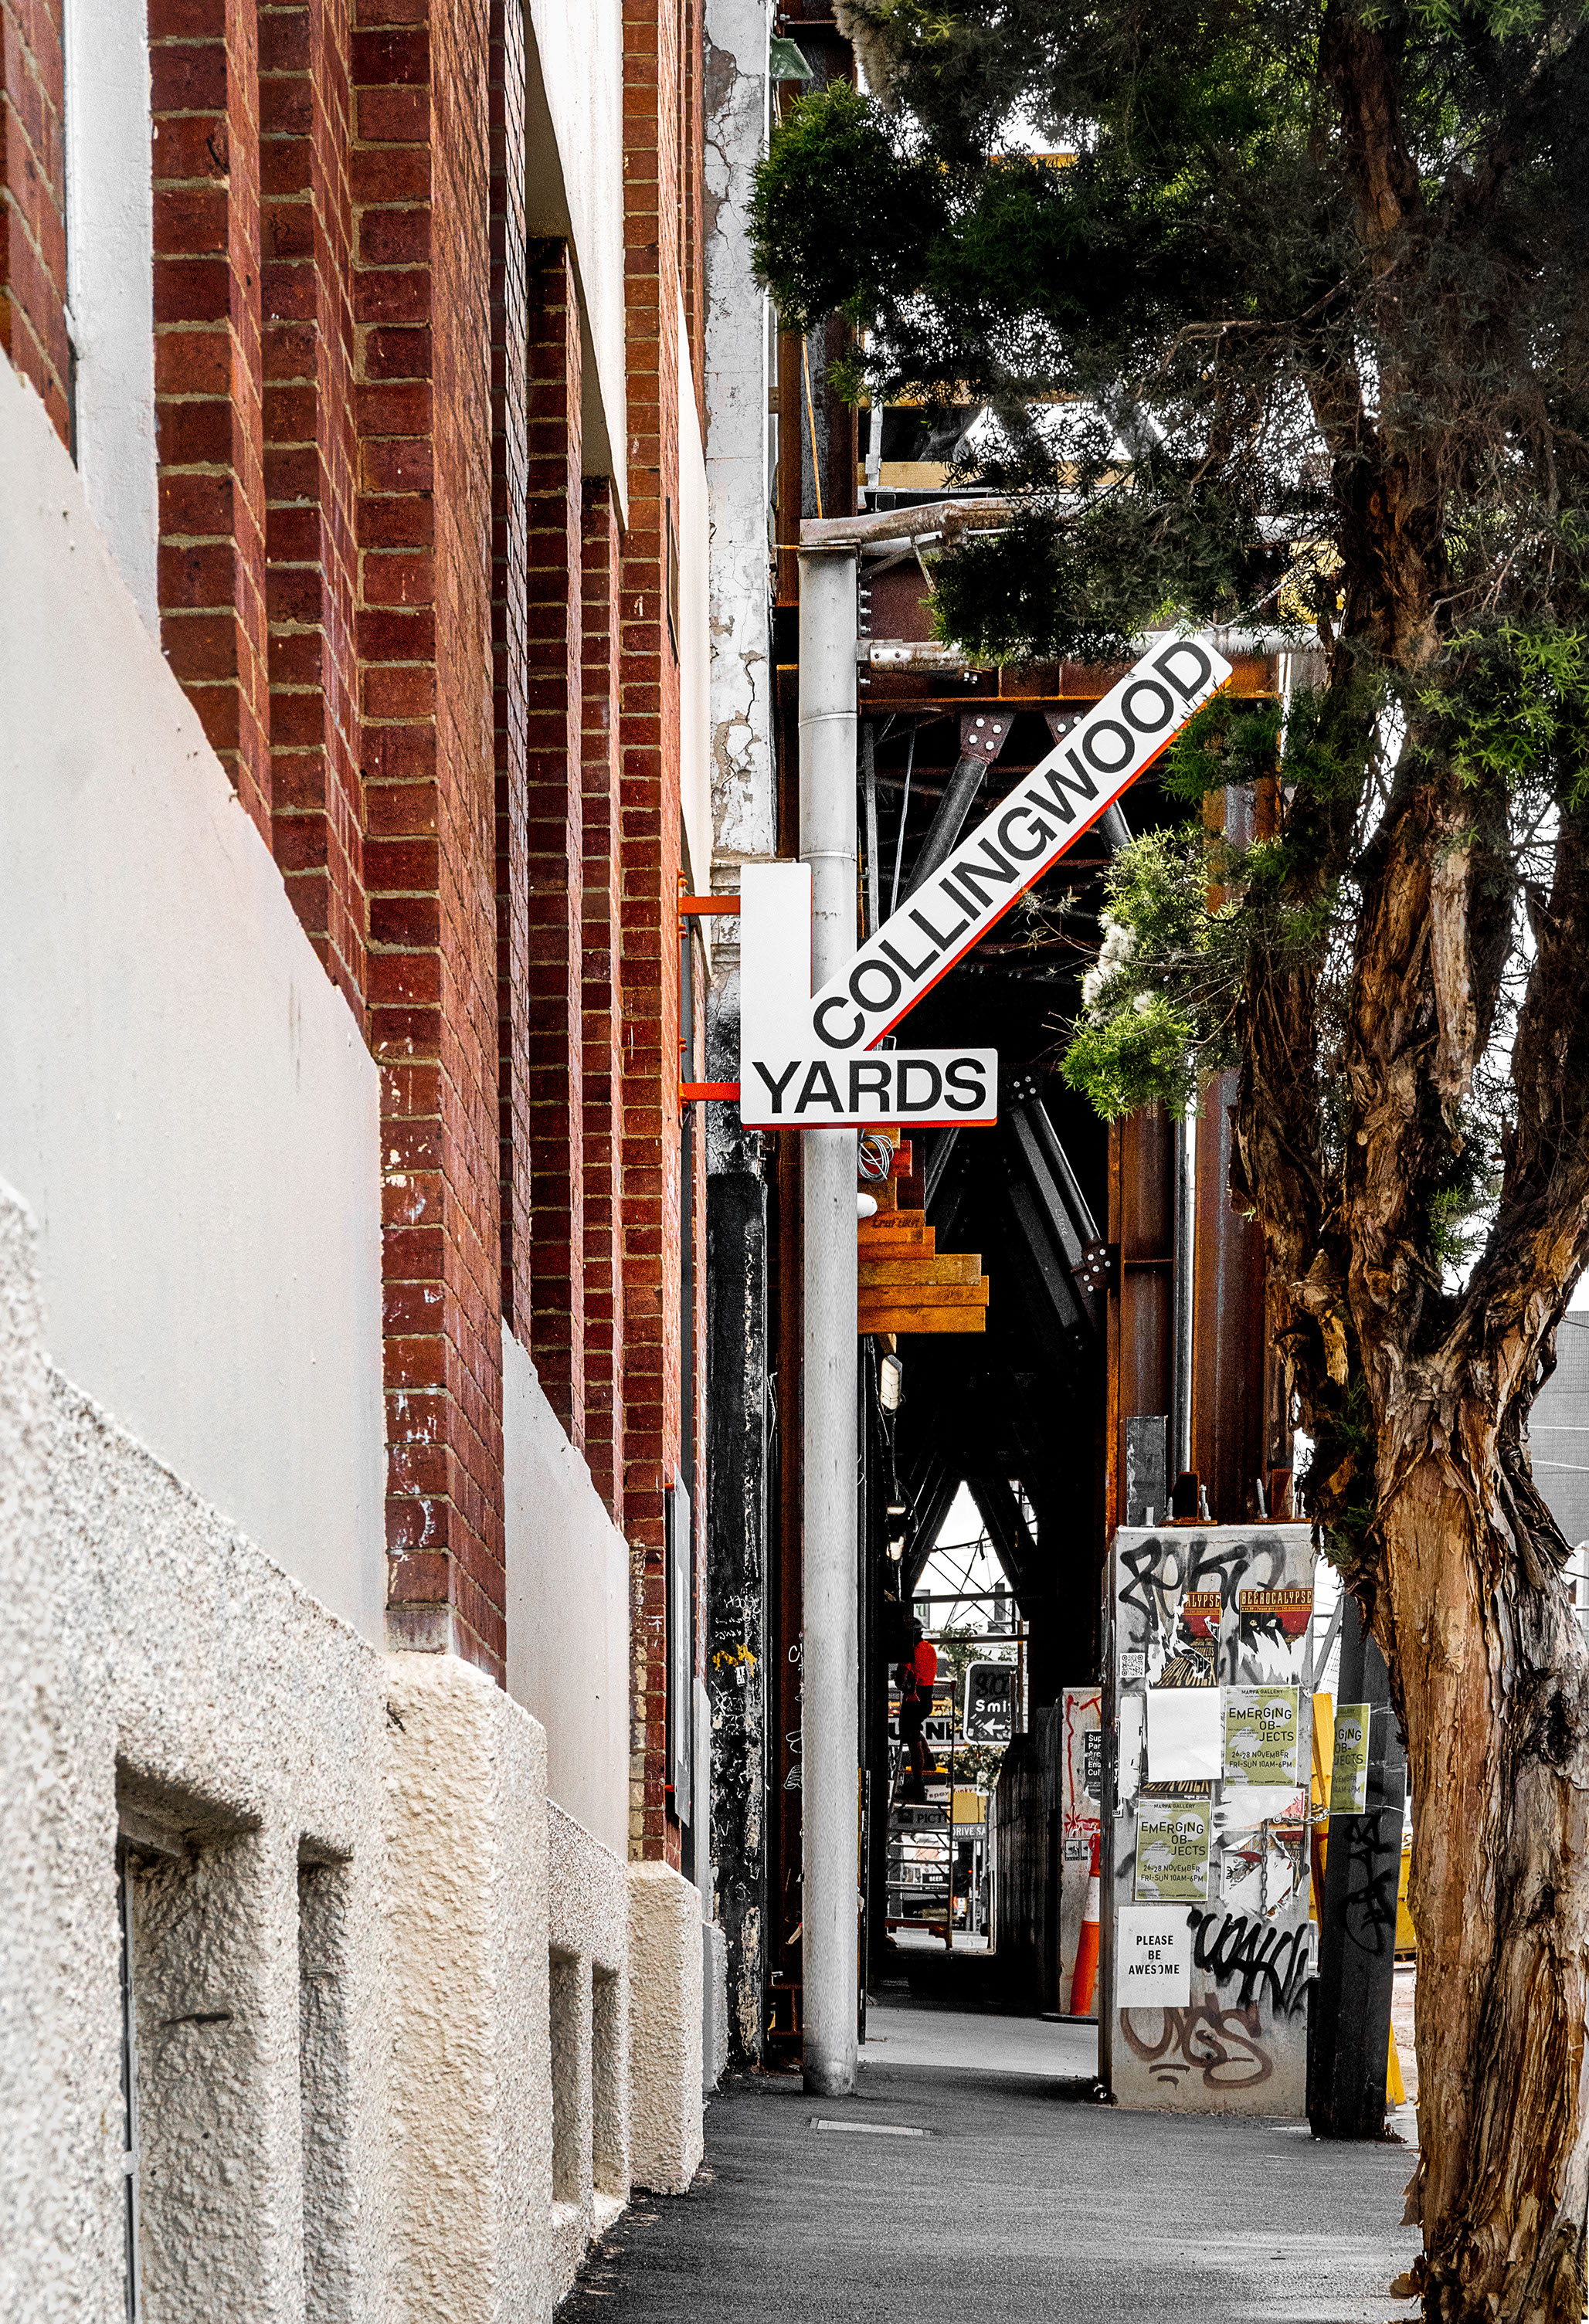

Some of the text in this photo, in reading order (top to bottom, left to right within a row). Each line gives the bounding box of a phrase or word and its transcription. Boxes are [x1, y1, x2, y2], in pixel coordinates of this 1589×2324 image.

[813, 641, 1213, 1049] COLLINGWOOD
[752, 1058, 987, 1115] YARDS
[1241, 1590, 1312, 1605] BEEROCALYPSE
[975, 1699, 1010, 1712] Smi
[1229, 1707, 1292, 1720] EMERGING
[1259, 1721, 1281, 1731] OB-
[1259, 1732, 1294, 1742] JECTS
[1231, 1749, 1289, 1759] 26-28 NOVEMBER
[1229, 1760, 1292, 1769] FRI-SUN 10AM-6PM
[1142, 1821, 1204, 1834] EMERGING
[1171, 1834, 1193, 1845] OB-
[1171, 1845, 1206, 1856] JECTS
[1143, 1863, 1200, 1873] 26-28 NOVEMBER
[1141, 1874, 1169, 1882] FRI-SUN
[1136, 1935, 1173, 1946] PLEASE
[1148, 1950, 1161, 1960] BE
[1129, 1964, 1180, 1975] AWESOME
